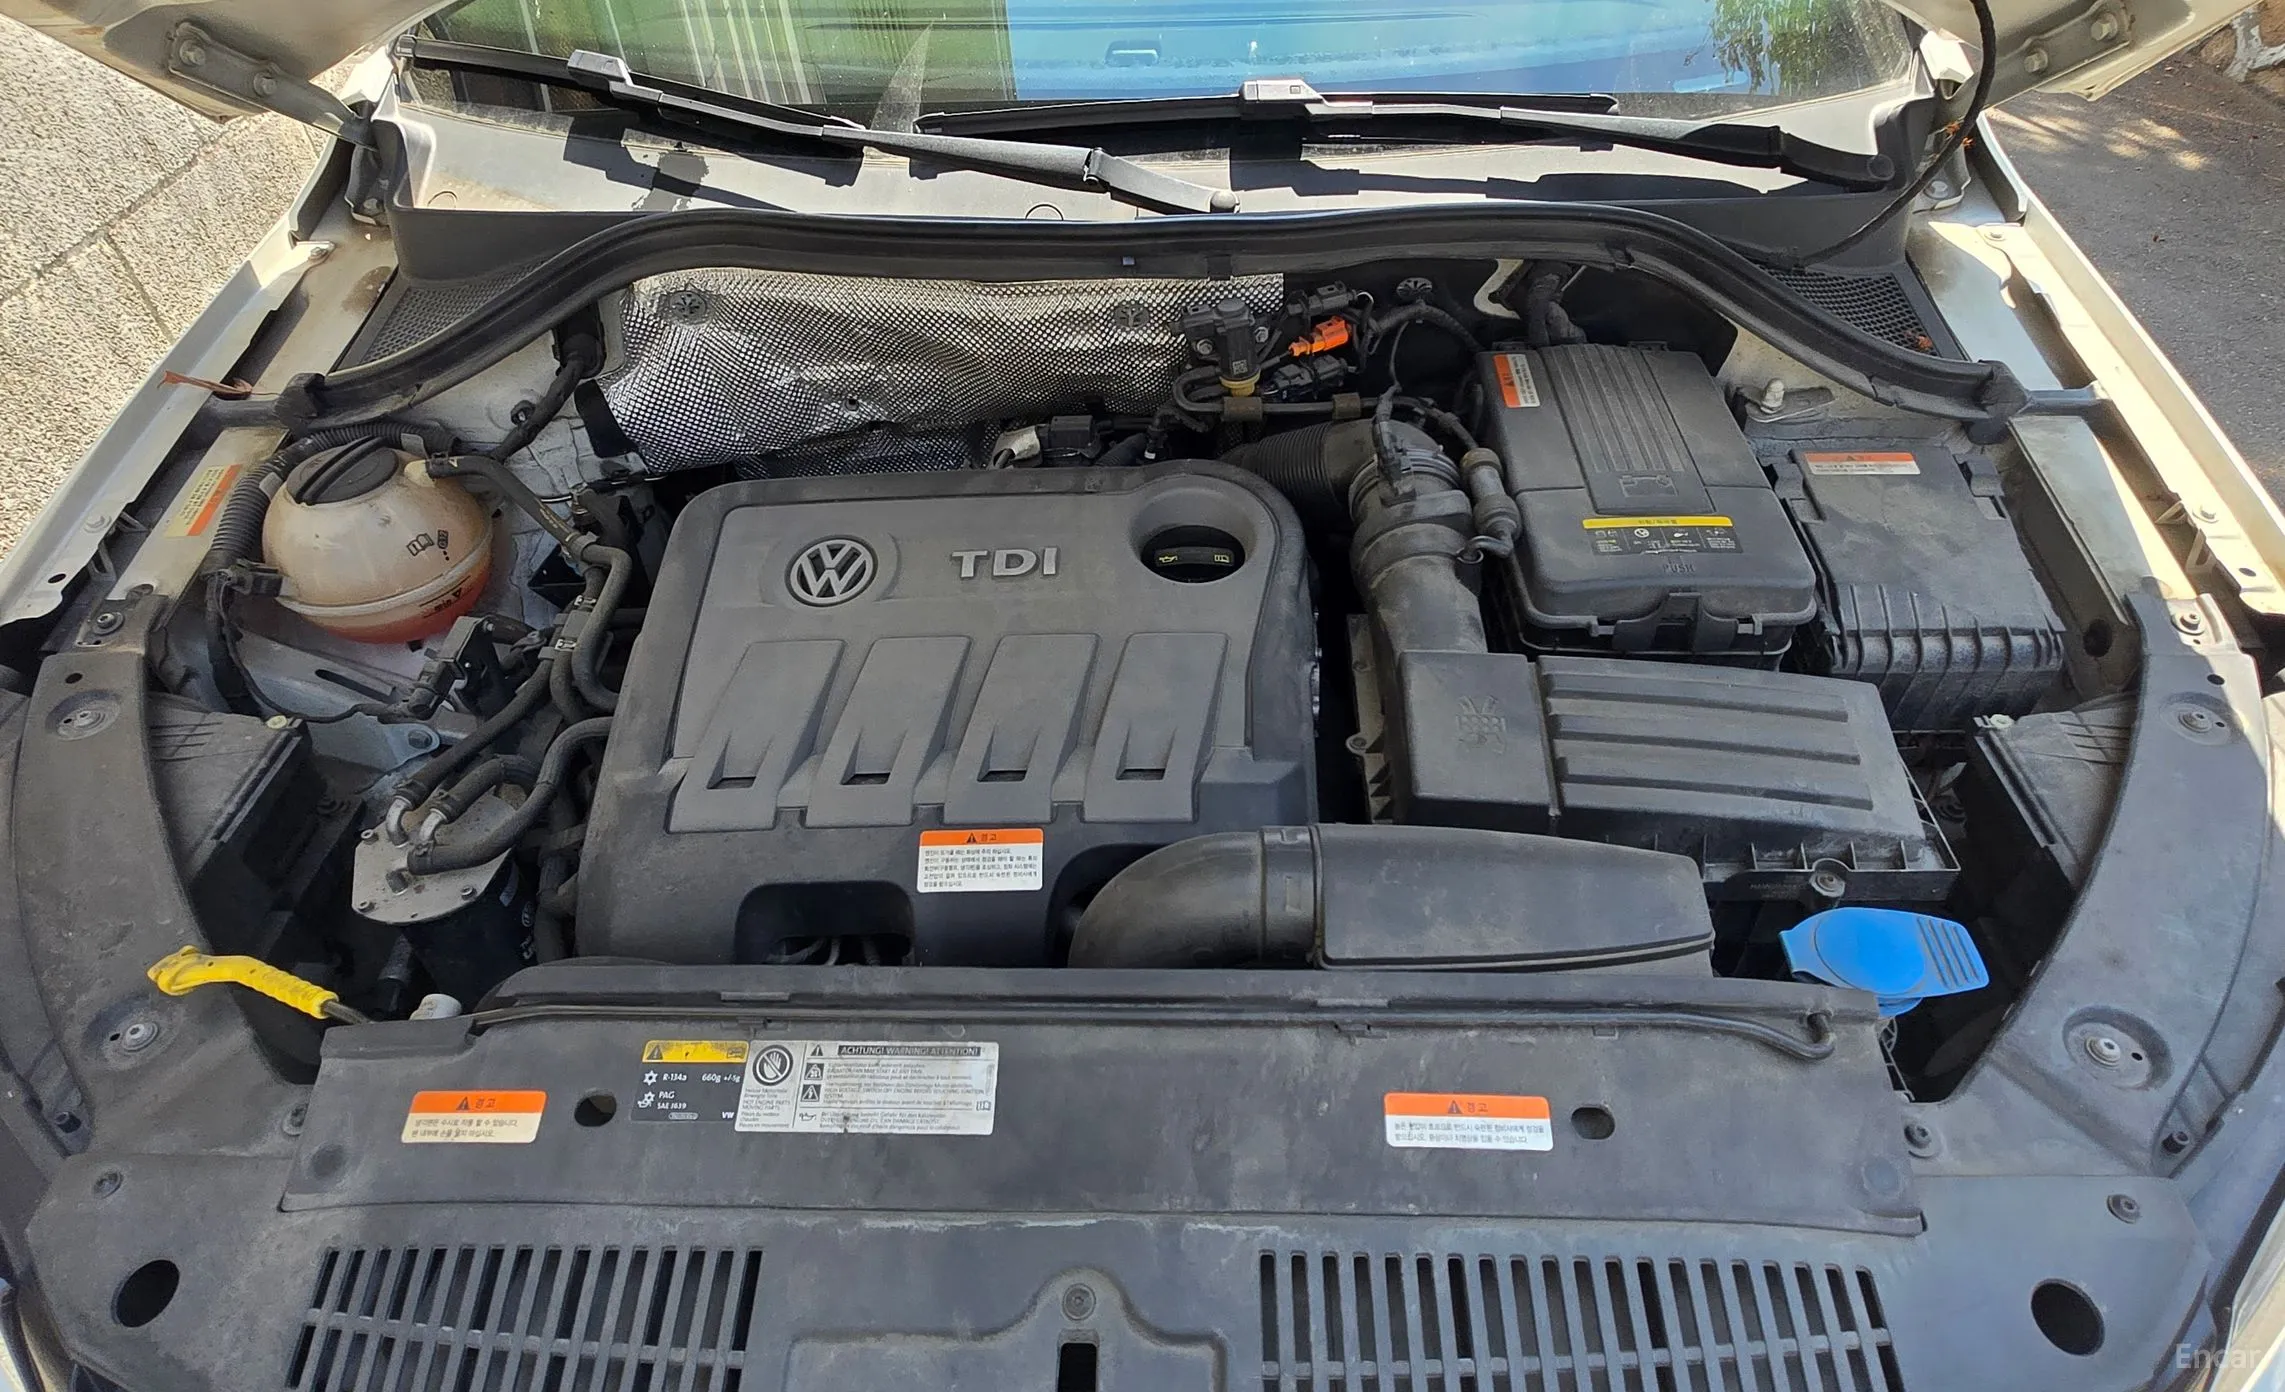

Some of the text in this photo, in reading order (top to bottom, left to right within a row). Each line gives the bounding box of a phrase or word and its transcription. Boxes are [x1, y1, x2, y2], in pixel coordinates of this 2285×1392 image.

[952, 547, 1057, 578] TDI
[1662, 563, 1696, 574] PUSH
[841, 1046, 979, 1056] ACHTUNG! WARNING! ATTENTION!
[662, 1073, 688, 1081] R-134a
[701, 1073, 721, 1083] 660g
[658, 1090, 675, 1099] PAG
[657, 1102, 687, 1110] SAE J639
[1467, 1102, 1489, 1113] 경고
[721, 1111, 735, 1120] VW
